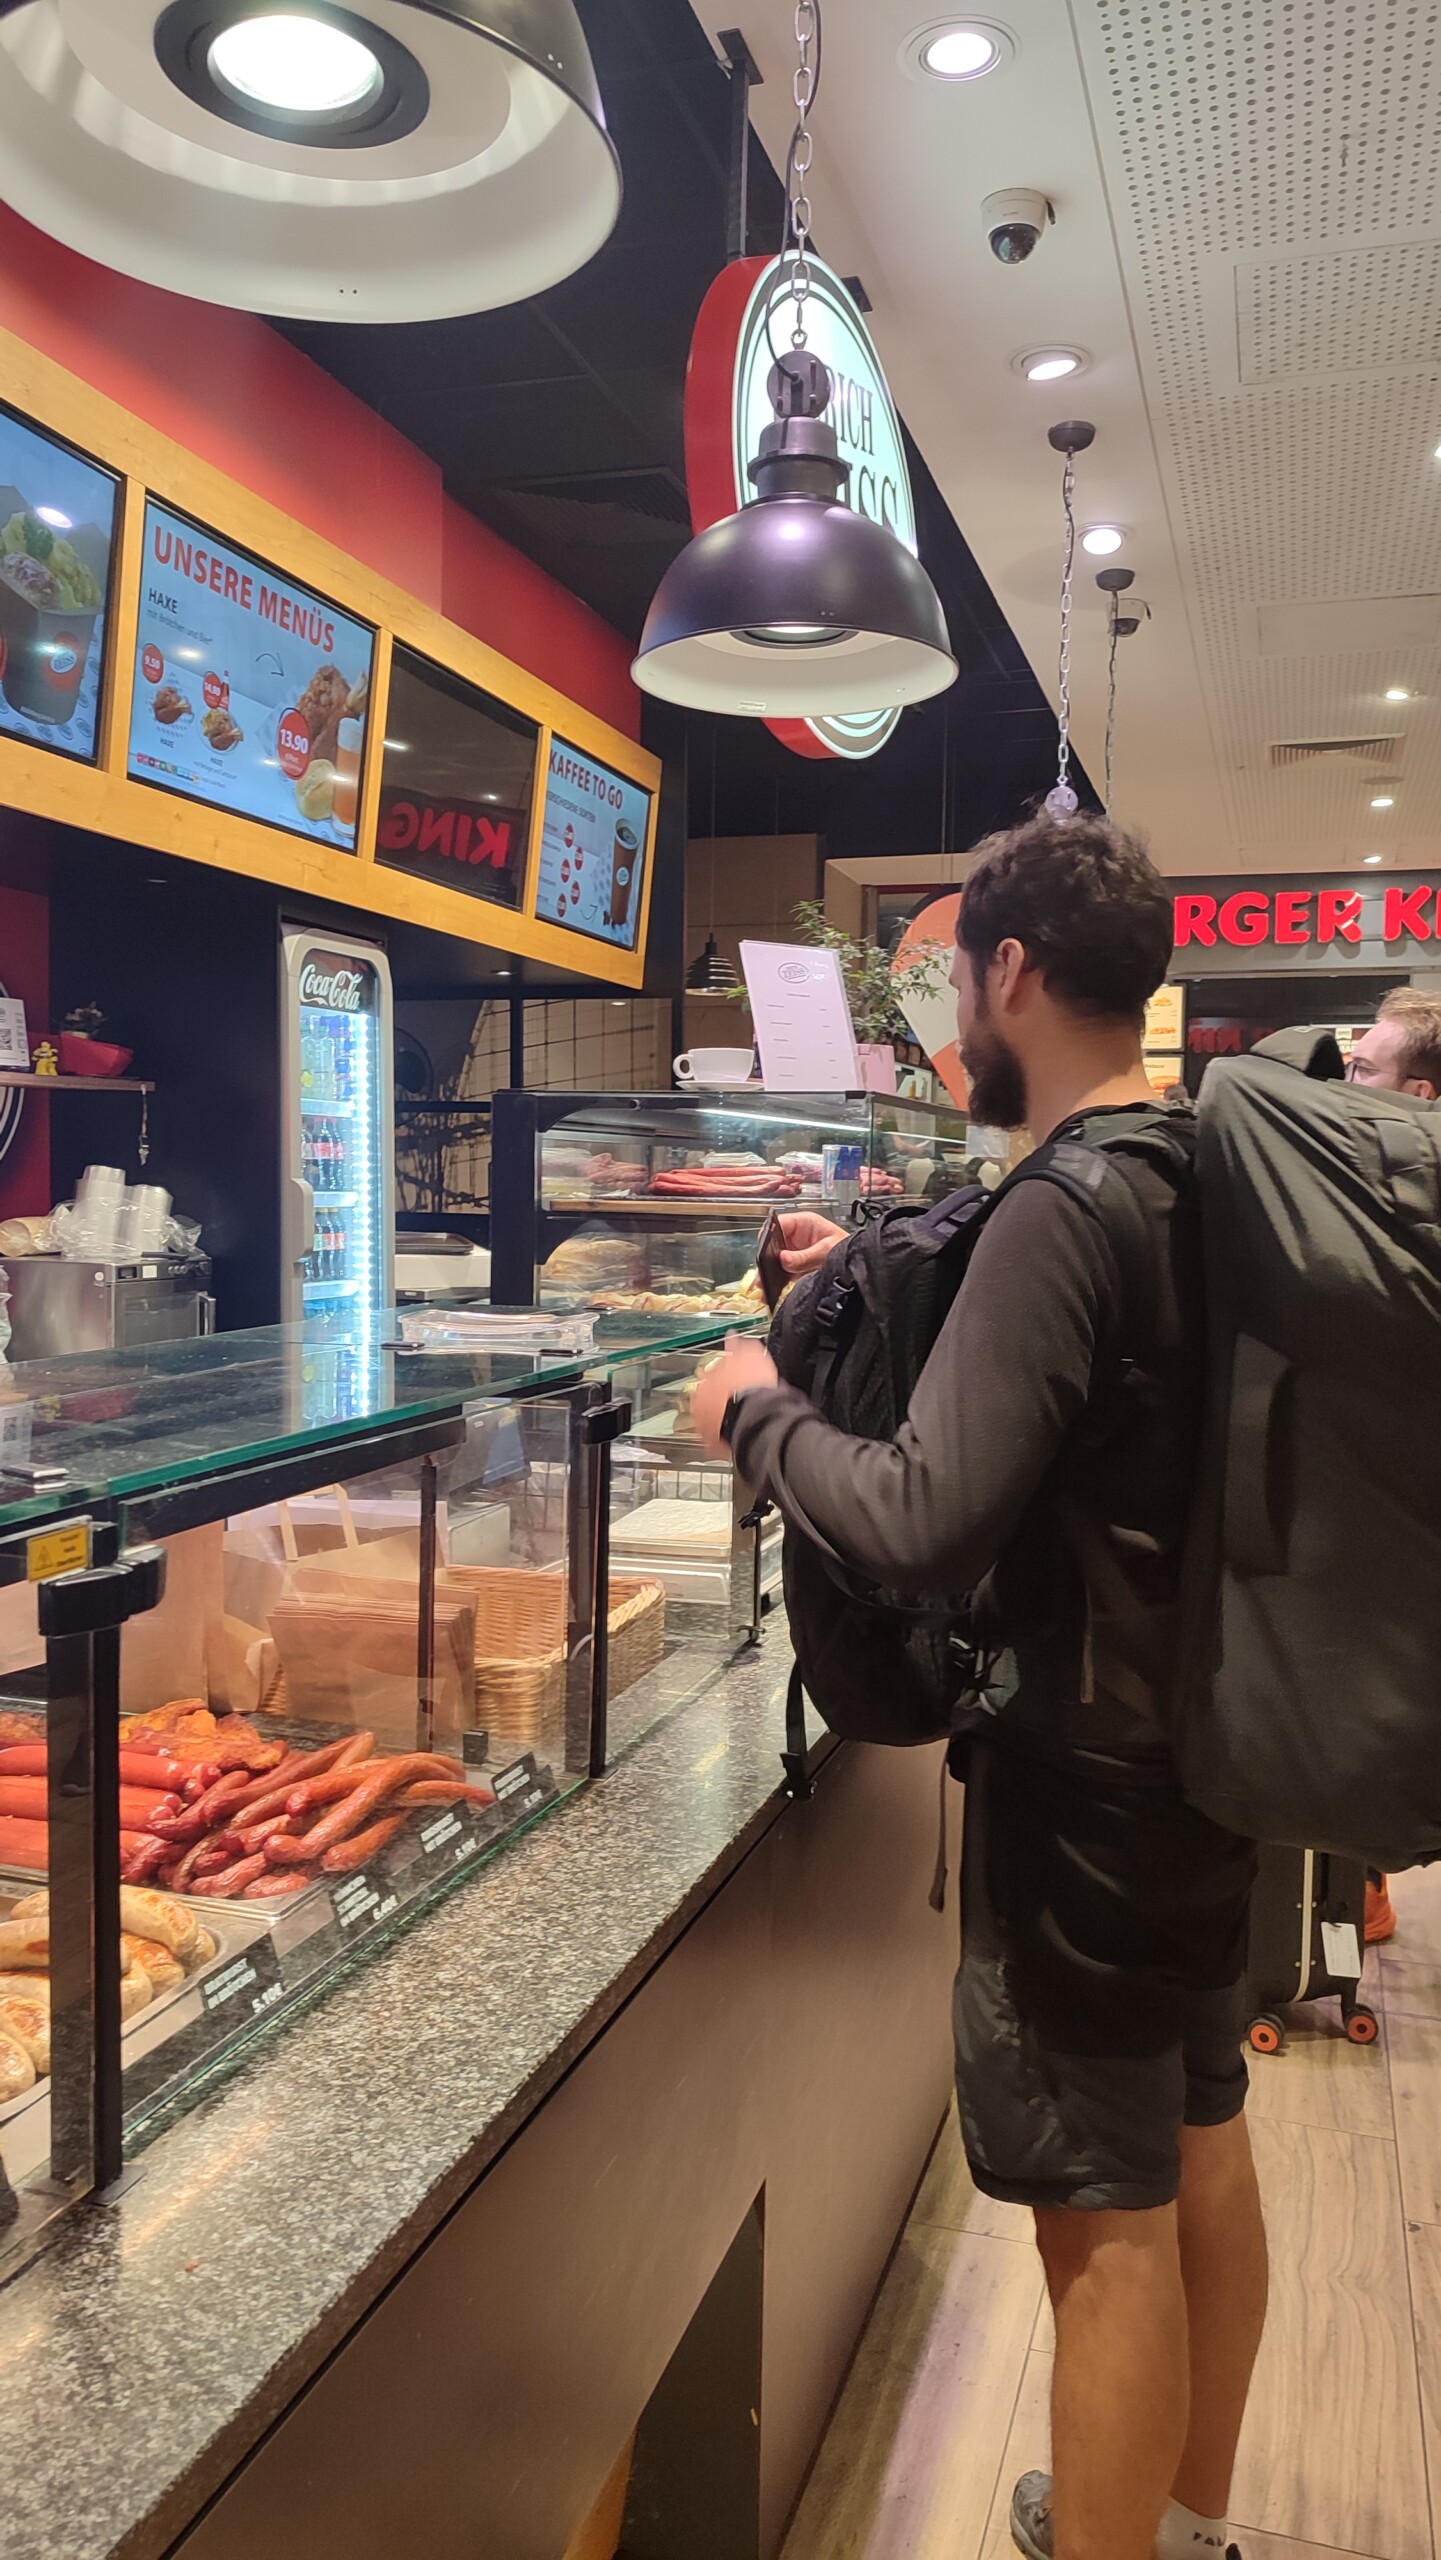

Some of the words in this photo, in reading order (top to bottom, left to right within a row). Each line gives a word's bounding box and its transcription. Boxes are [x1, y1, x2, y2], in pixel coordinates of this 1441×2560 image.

[826, 364, 876, 456] RICH
[148, 587, 178, 614] HAXE
[154, 525, 253, 610] UNSERE
[258, 585, 335, 653] MENÜS
[280, 728, 309, 754] 13.90
[549, 748, 591, 792] KAFFEE
[593, 774, 606, 800] TO
[608, 785, 623, 810] GO
[1173, 891, 1363, 947] RGER
[1384, 886, 1441, 941] K
